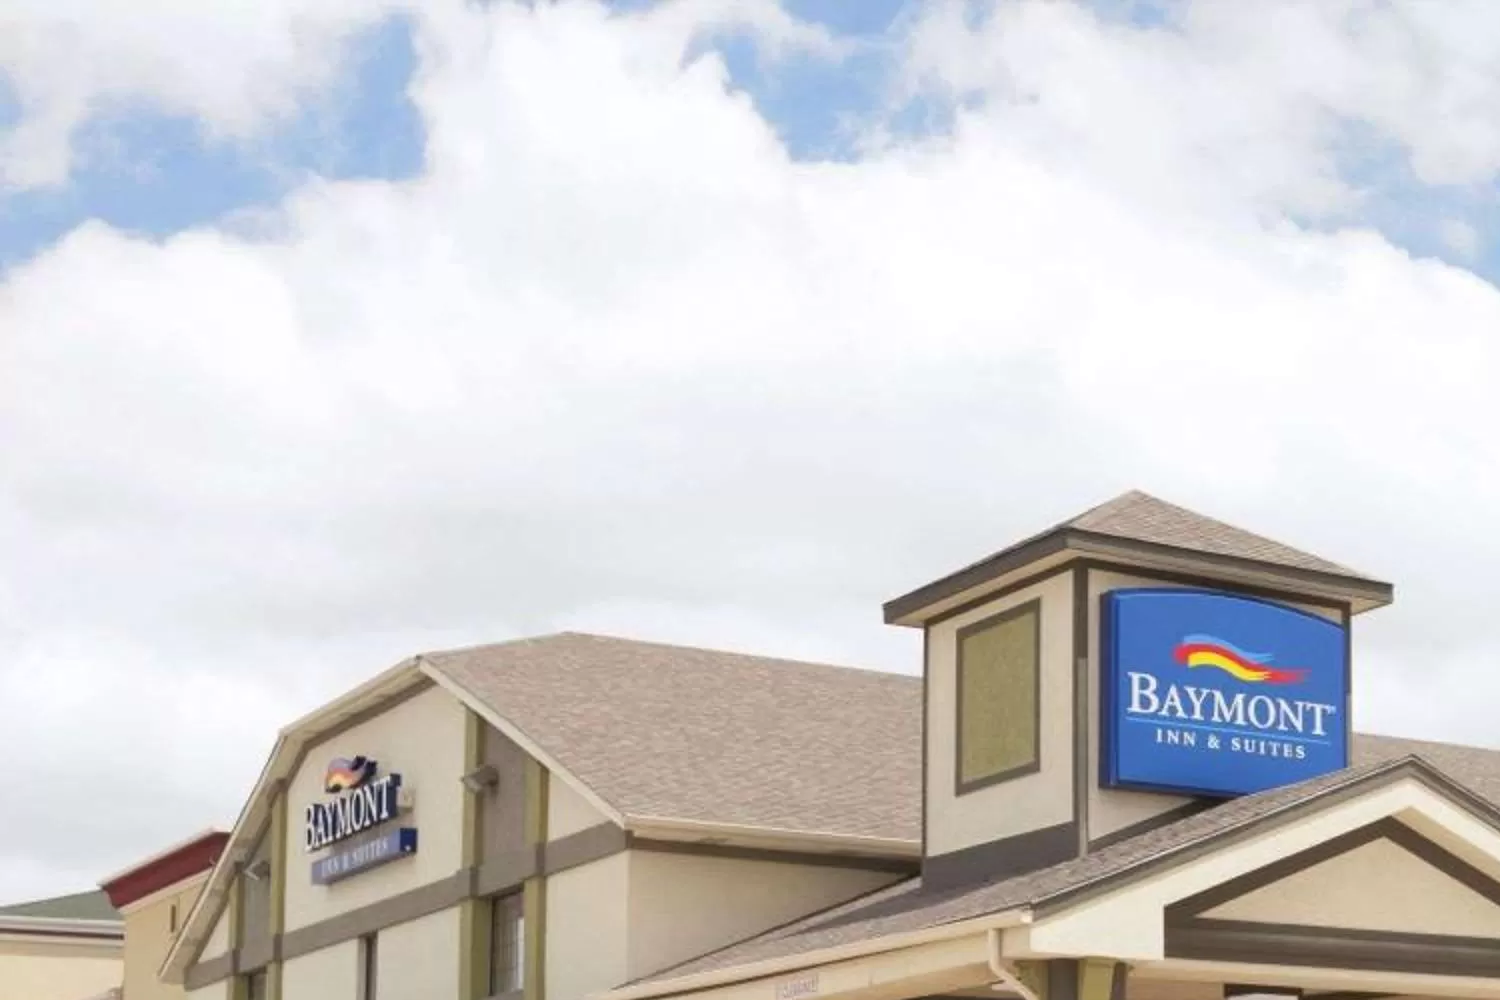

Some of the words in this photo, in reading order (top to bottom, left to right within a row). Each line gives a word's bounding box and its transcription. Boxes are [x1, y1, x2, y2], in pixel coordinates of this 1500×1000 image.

[1127, 671, 1332, 736] BAYMONT
[1156, 728, 1196, 747] INN
[1207, 734, 1220, 749] &
[1231, 737, 1306, 759] SUITES
[305, 776, 391, 851] BAYMONT
[351, 837, 389, 864] SUITES
